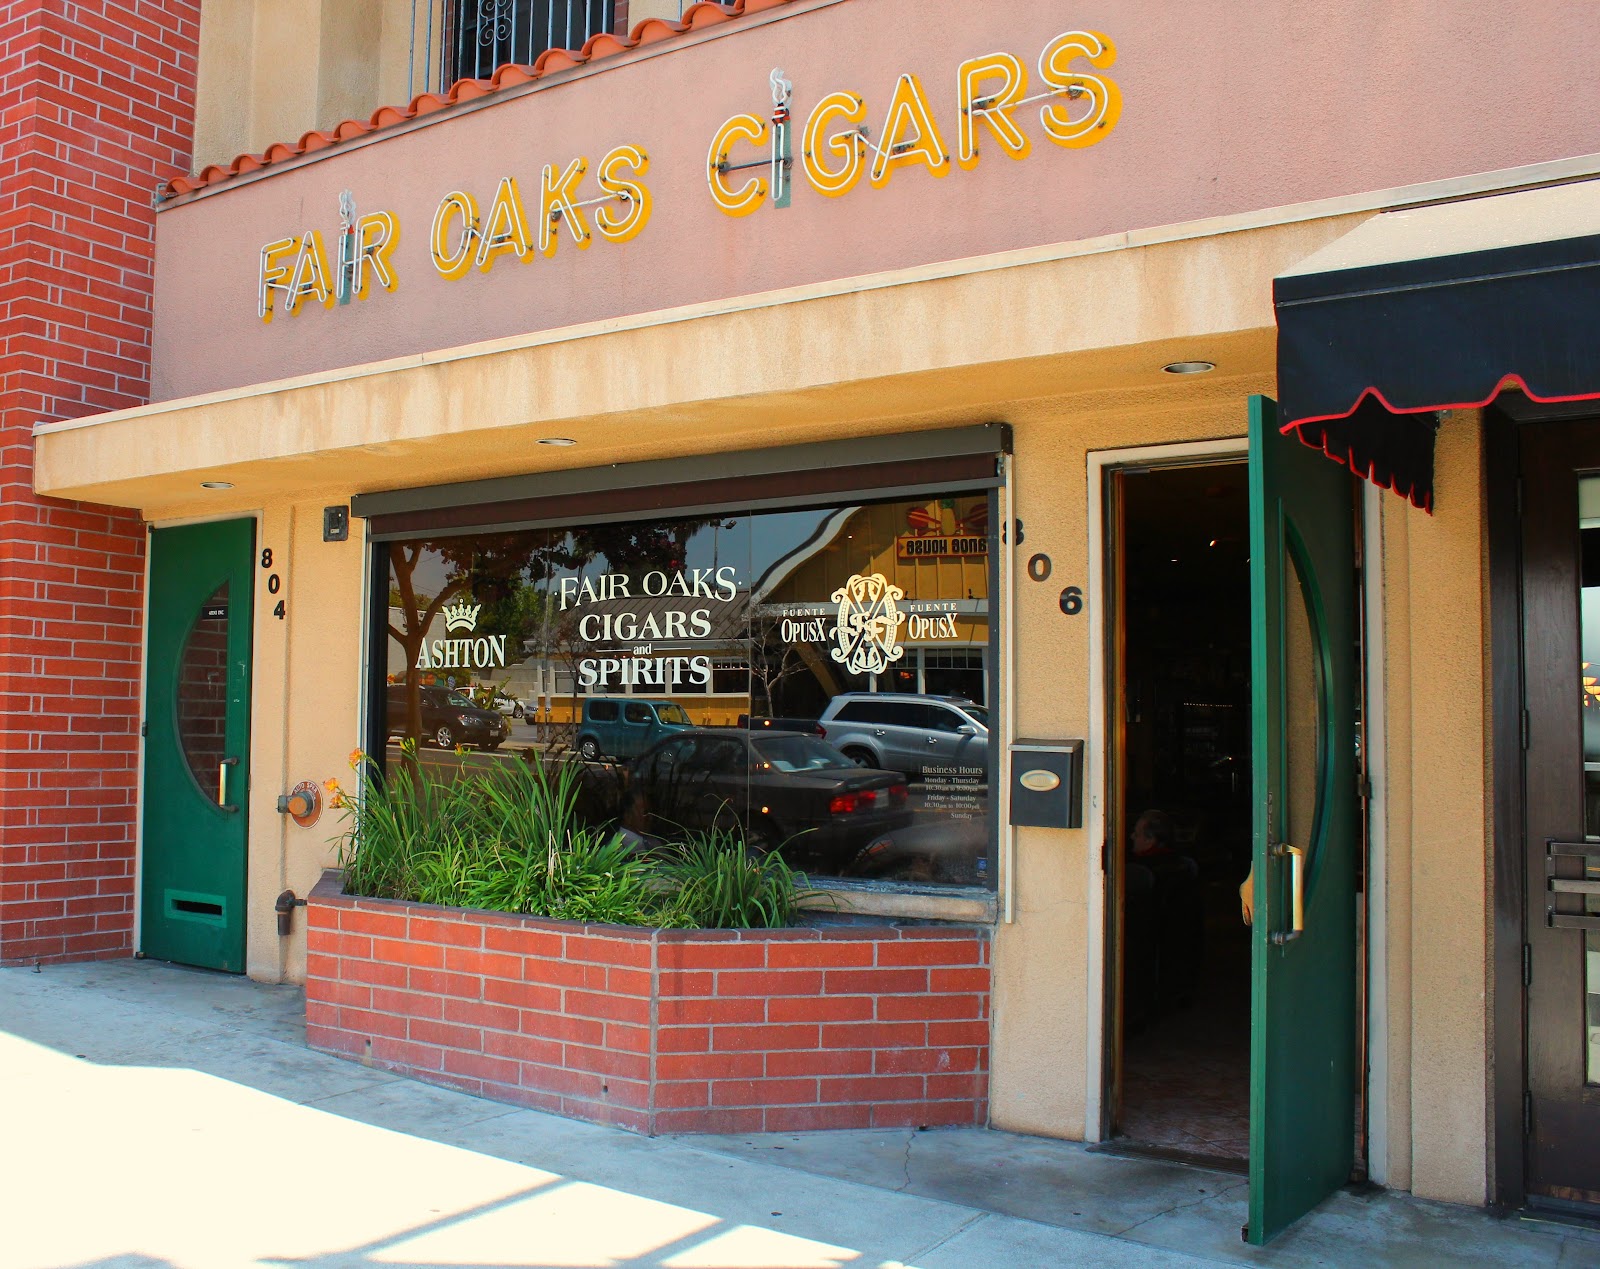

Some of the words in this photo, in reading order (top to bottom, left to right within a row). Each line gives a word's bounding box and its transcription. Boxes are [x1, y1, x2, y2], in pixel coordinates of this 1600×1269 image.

[257, 190, 400, 324] FAIR
[430, 143, 653, 281] OAKS
[706, 29, 1122, 217] CIGARS
[261, 548, 286, 620] 804
[559, 574, 631, 611] FAIR
[642, 566, 738, 602] OAKS
[782, 607, 827, 617] FUENTE
[910, 602, 958, 613] FUENTE
[578, 609, 712, 642] CIGARS
[415, 634, 507, 669] ASHTON
[633, 642, 653, 656] and
[578, 655, 712, 687] SPIRITS
[922, 765, 957, 774] Business
[959, 766, 983, 775] Hours
[927, 794, 946, 803] Friday
[950, 795, 977, 803] Saturday
